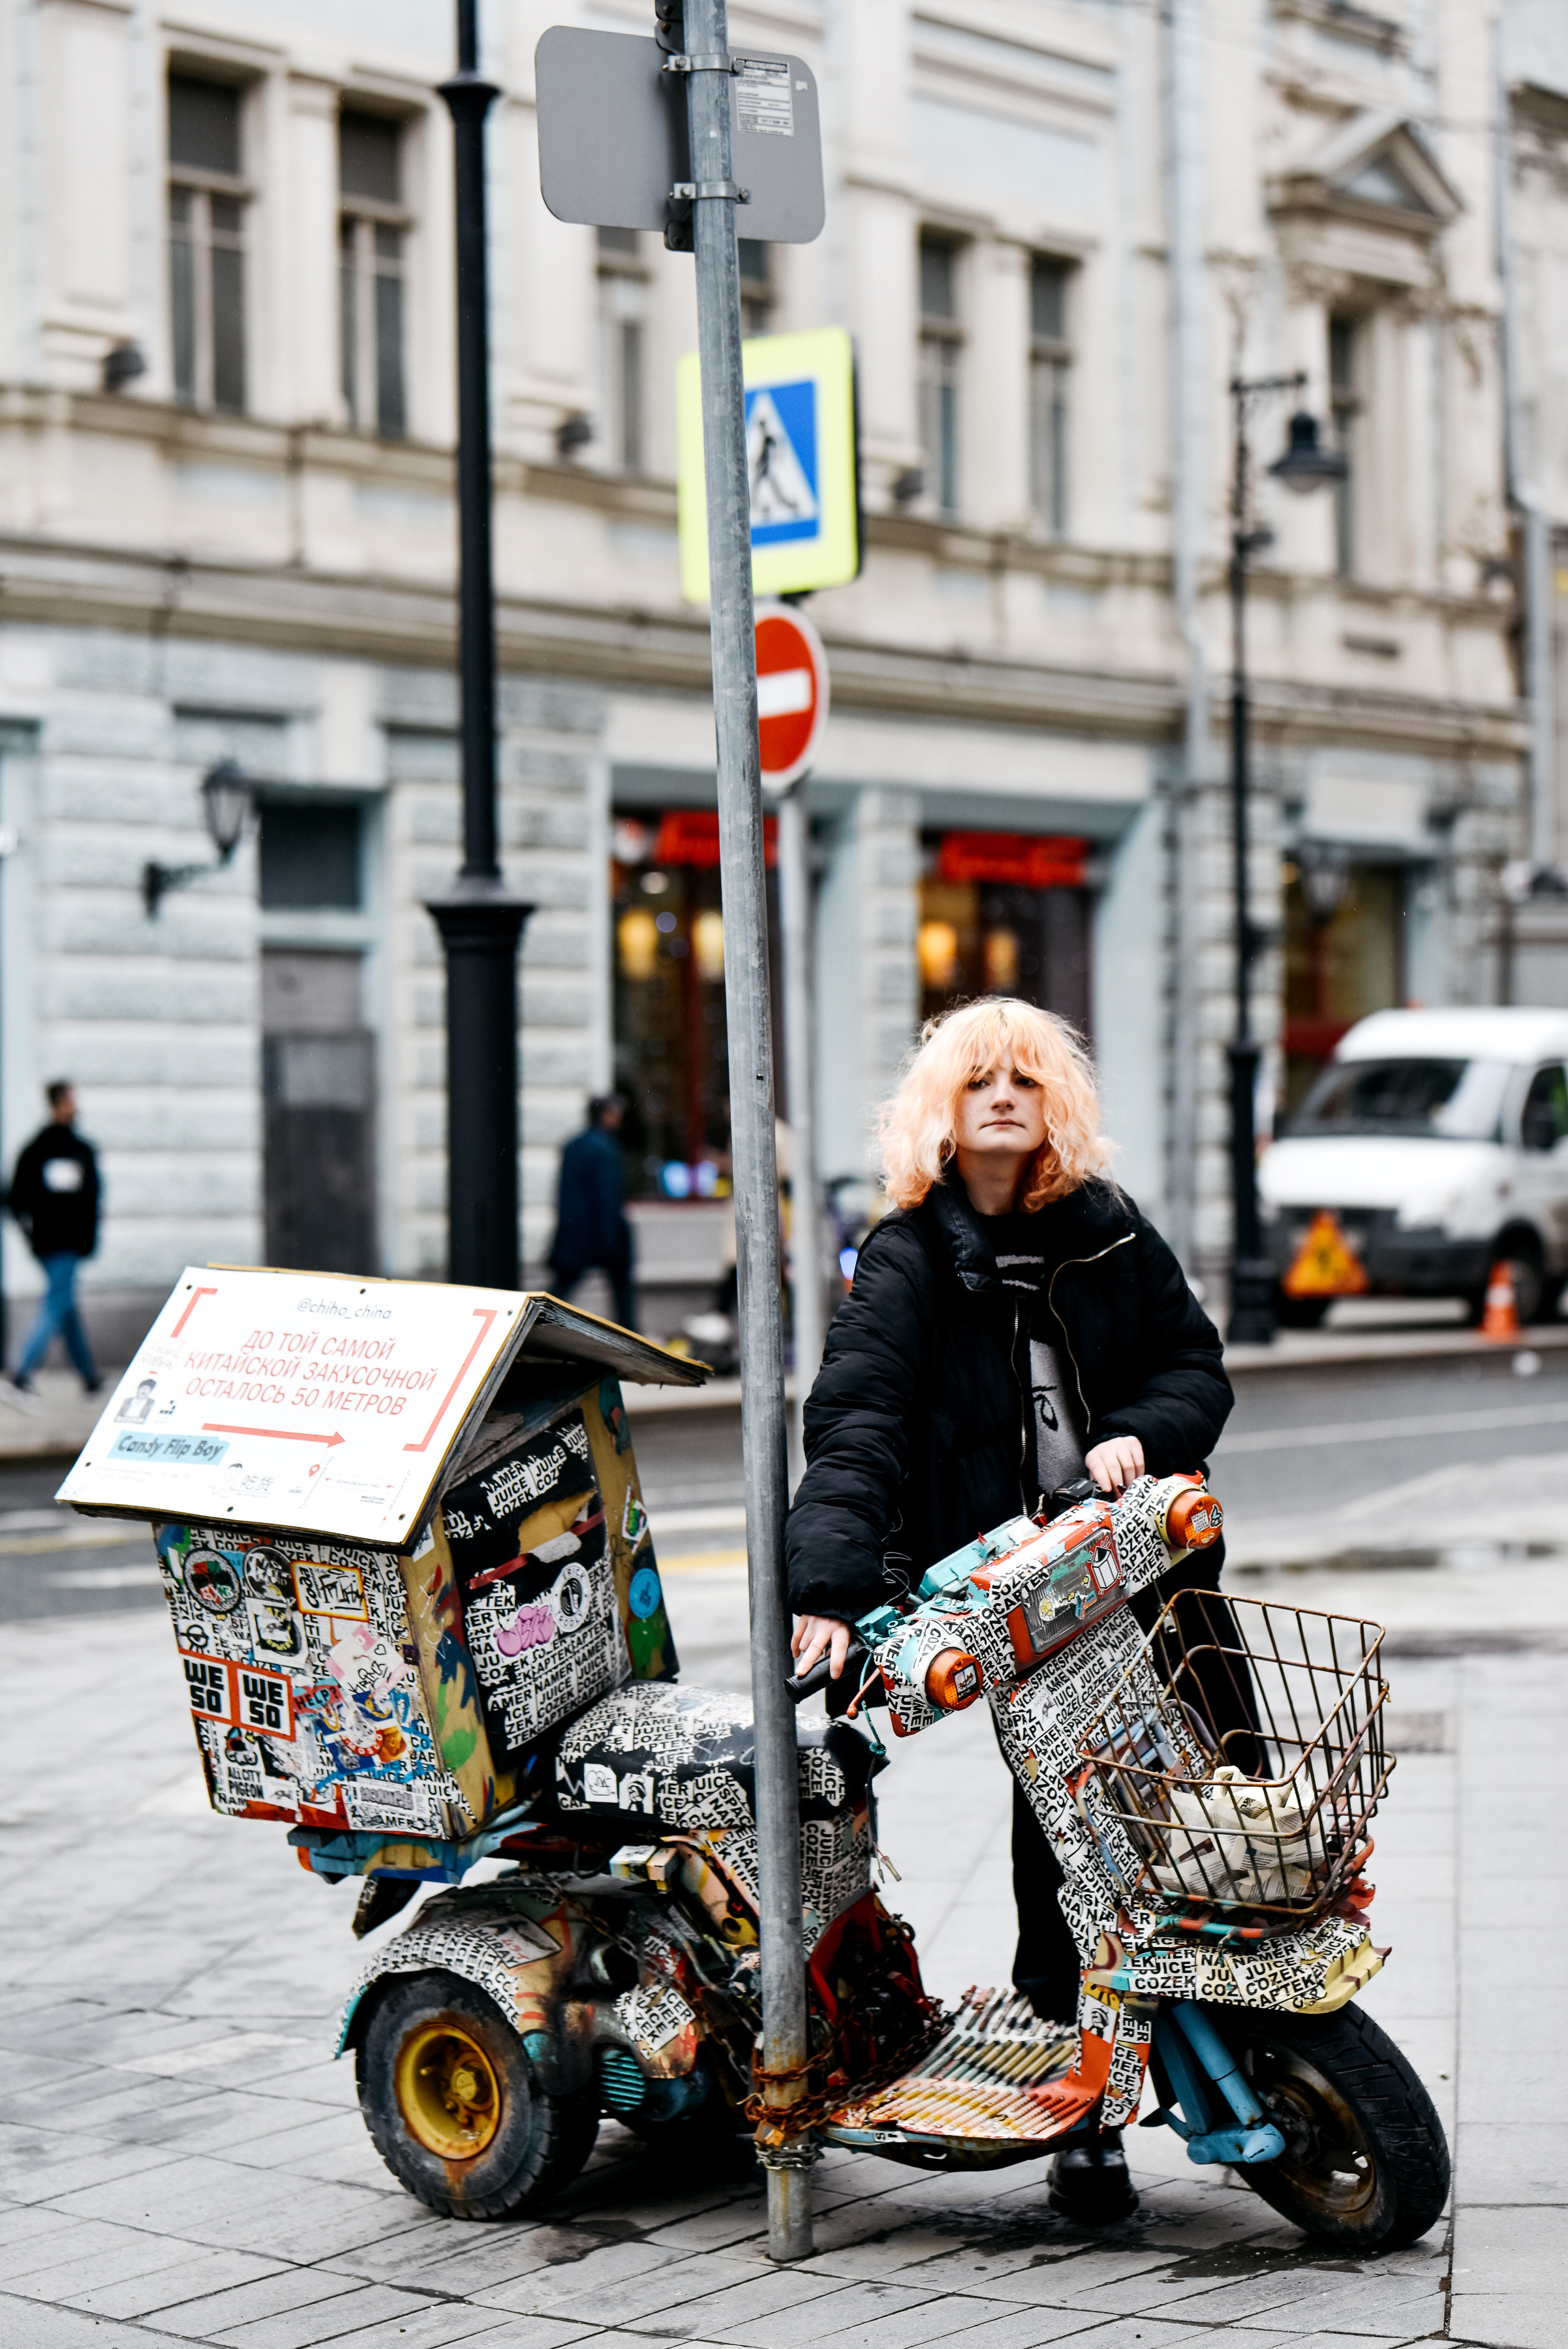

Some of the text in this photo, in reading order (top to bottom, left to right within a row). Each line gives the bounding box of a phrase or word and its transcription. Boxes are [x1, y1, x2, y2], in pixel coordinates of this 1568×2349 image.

[297, 1298, 393, 1319] @chiho_china
[241, 1330, 397, 1360] ДО ТОЙ САМОЙ
[183, 1349, 301, 1379] КИТАЙСКОЙ
[303, 1362, 438, 1391] ЗАКУСОЧНОЙ
[186, 1377, 407, 1415] ОСТАЛОСЬ 50 МЕТРОВ
[117, 1436, 224, 1461] Candy Flip Boy
[536, 1446, 566, 1477] JUICE
[493, 1477, 528, 1508] JUICE
[495, 1487, 535, 1518] COZEK
[183, 1659, 224, 1691] WE
[577, 1651, 607, 1680] JUICE
[1067, 1645, 1098, 1678] NAMER
[1080, 1657, 1106, 1689] JUICE
[242, 1674, 284, 1706] WE
[534, 1663, 574, 1694] NAMER
[540, 1678, 572, 1705] JUICE
[190, 1684, 222, 1713] SO
[537, 1689, 576, 1717] COZEK
[249, 1700, 281, 1729] SO
[634, 1725, 684, 1736] JUICE
[228, 1779, 264, 1800] PIGEON
[1135, 1975, 1196, 1990] COZEK
[1246, 1957, 1298, 1980] JUICE
[1246, 1965, 1305, 1996] COZEK
[1247, 1973, 1319, 2009] CAPTEK
